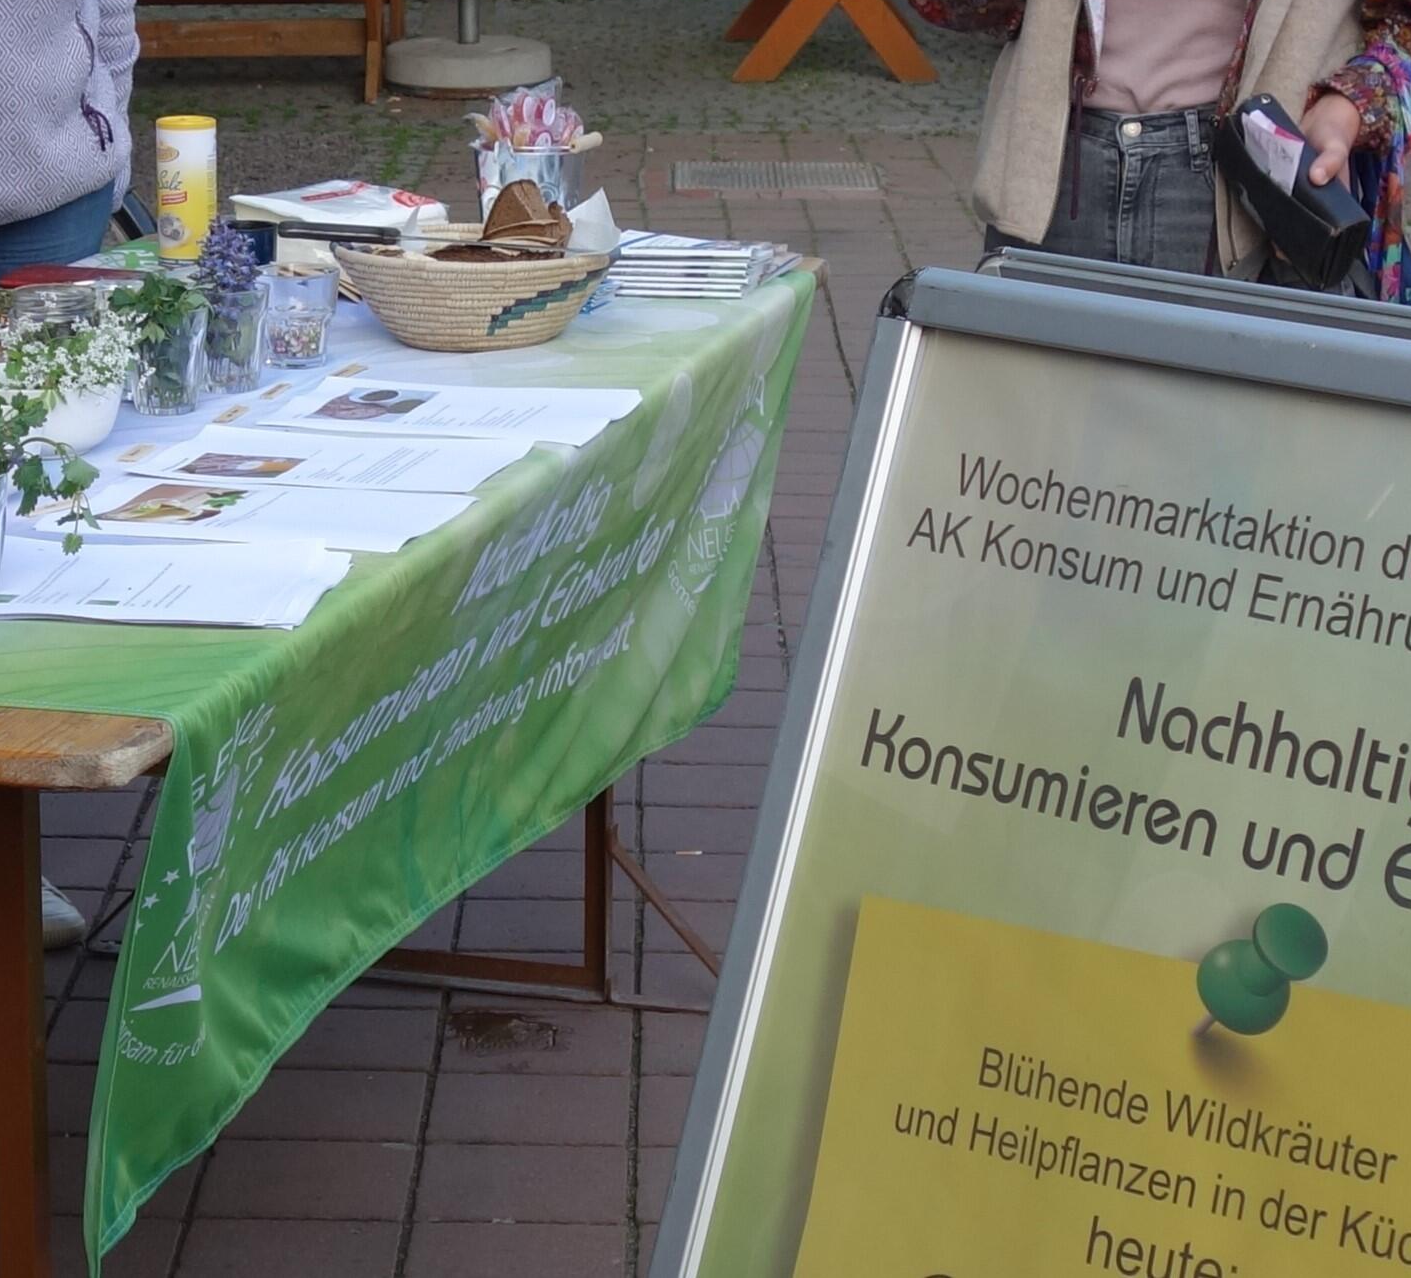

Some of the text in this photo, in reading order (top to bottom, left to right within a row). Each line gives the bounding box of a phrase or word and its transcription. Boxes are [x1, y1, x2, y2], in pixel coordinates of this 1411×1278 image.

[907, 507, 973, 559] AK
[981, 521, 1143, 593] Konsum
[1156, 568, 1238, 612] und
[959, 453, 1365, 571] Wochenmarktaktion
[291, 779, 385, 876] Konsum
[386, 730, 441, 801] und
[860, 708, 1217, 857] Konsumieren
[1241, 820, 1365, 892] und
[894, 1103, 959, 1145] und
[969, 1113, 1197, 1208] Heilpflanzen
[1211, 1174, 1246, 1220] in
[1259, 1190, 1328, 1240] der
[978, 1047, 1399, 1184] Blühende Wildkräuter
